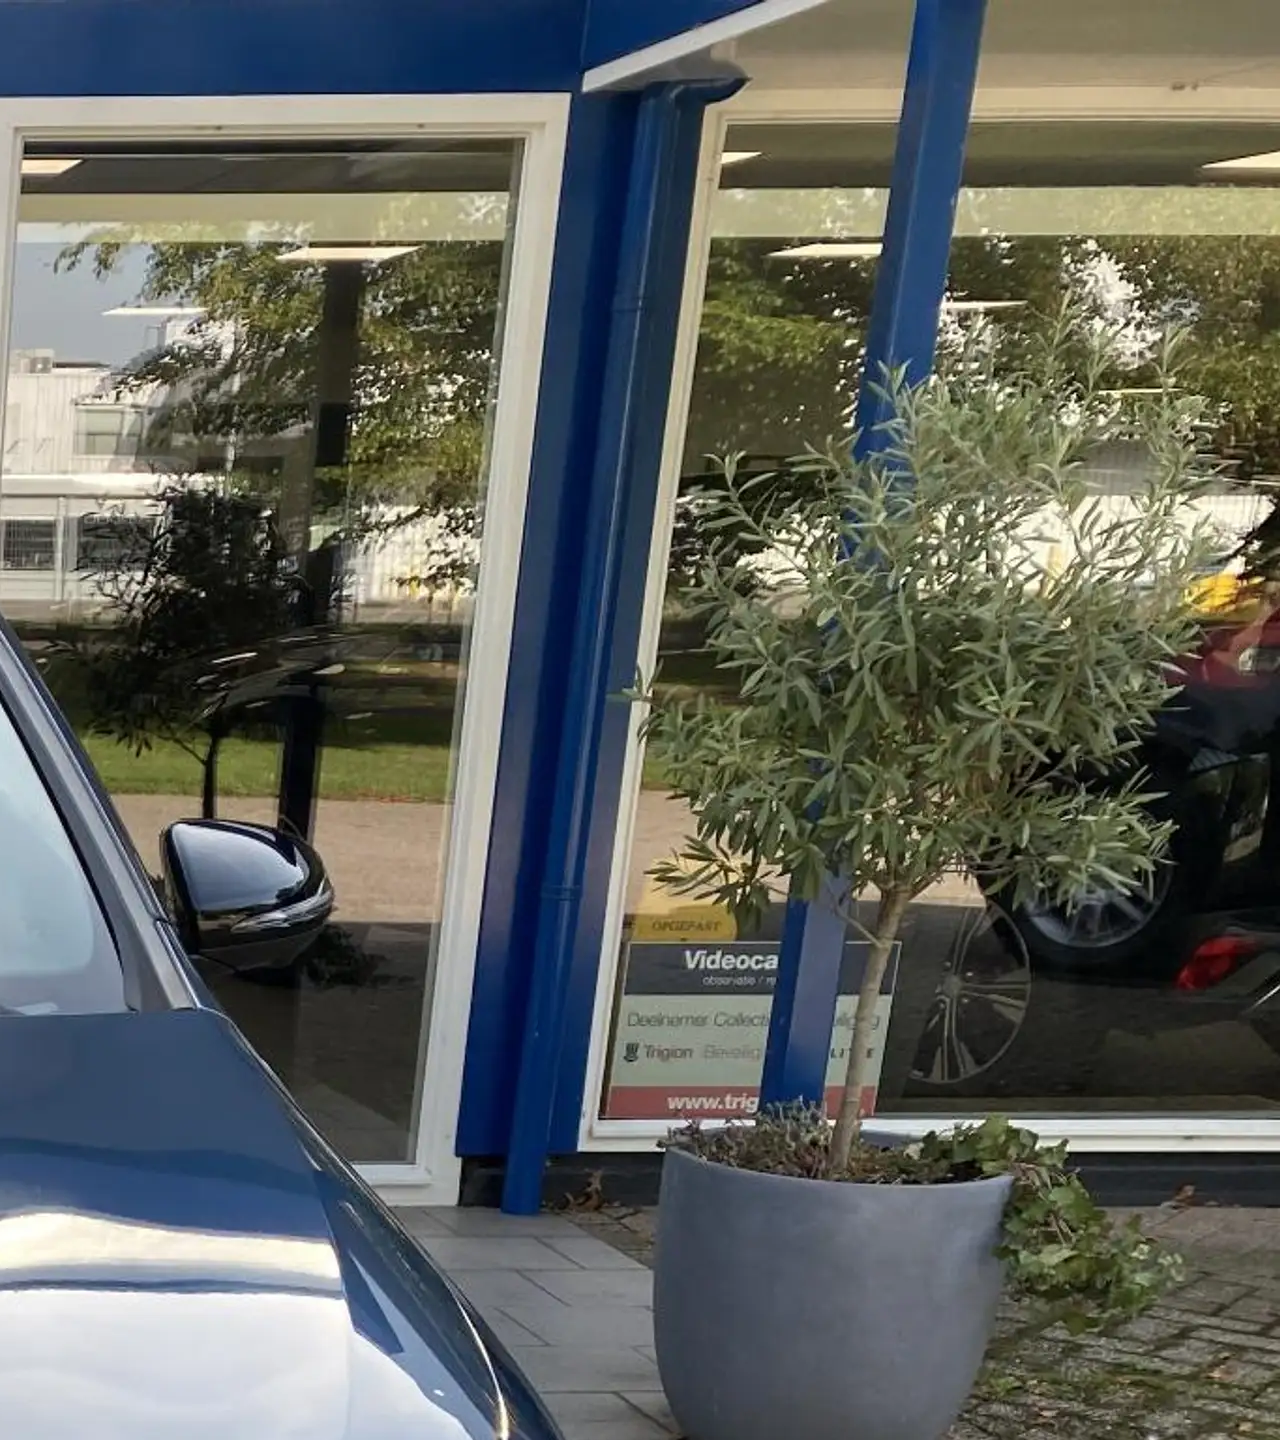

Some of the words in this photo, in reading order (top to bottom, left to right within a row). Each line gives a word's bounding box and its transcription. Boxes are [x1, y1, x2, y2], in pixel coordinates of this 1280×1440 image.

[684, 950, 778, 969] Videoca
[644, 1045, 692, 1061] Trigion
[667, 1093, 759, 1112] www.trig
